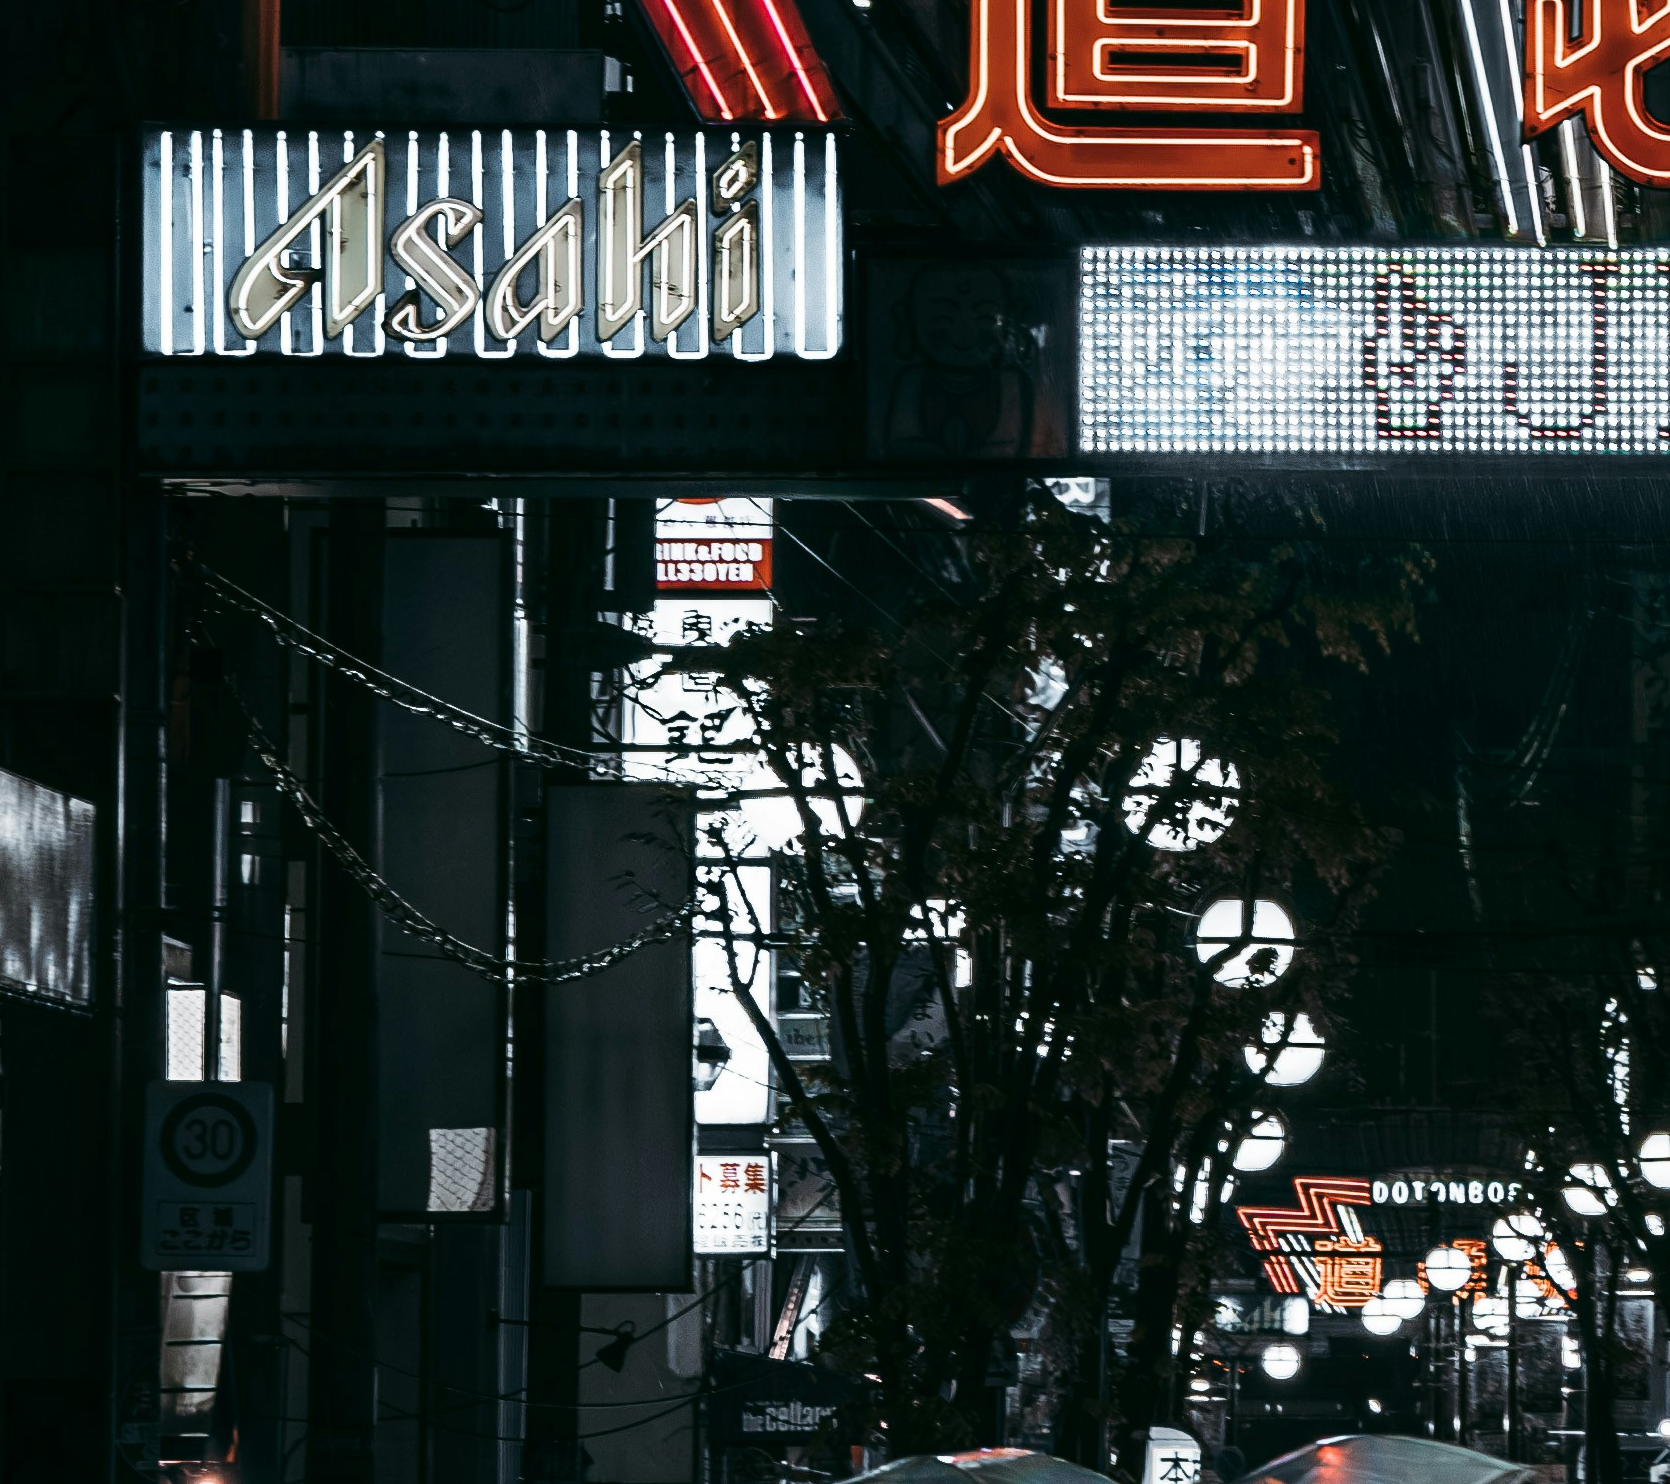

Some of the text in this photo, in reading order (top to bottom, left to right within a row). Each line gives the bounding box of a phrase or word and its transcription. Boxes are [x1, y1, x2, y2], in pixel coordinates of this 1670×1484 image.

[231, 138, 759, 343] Asahi
[183, 1118, 235, 1160] 30
[1372, 1180, 1533, 1205] DOTONBO
[159, 1228, 251, 1251] ここから
